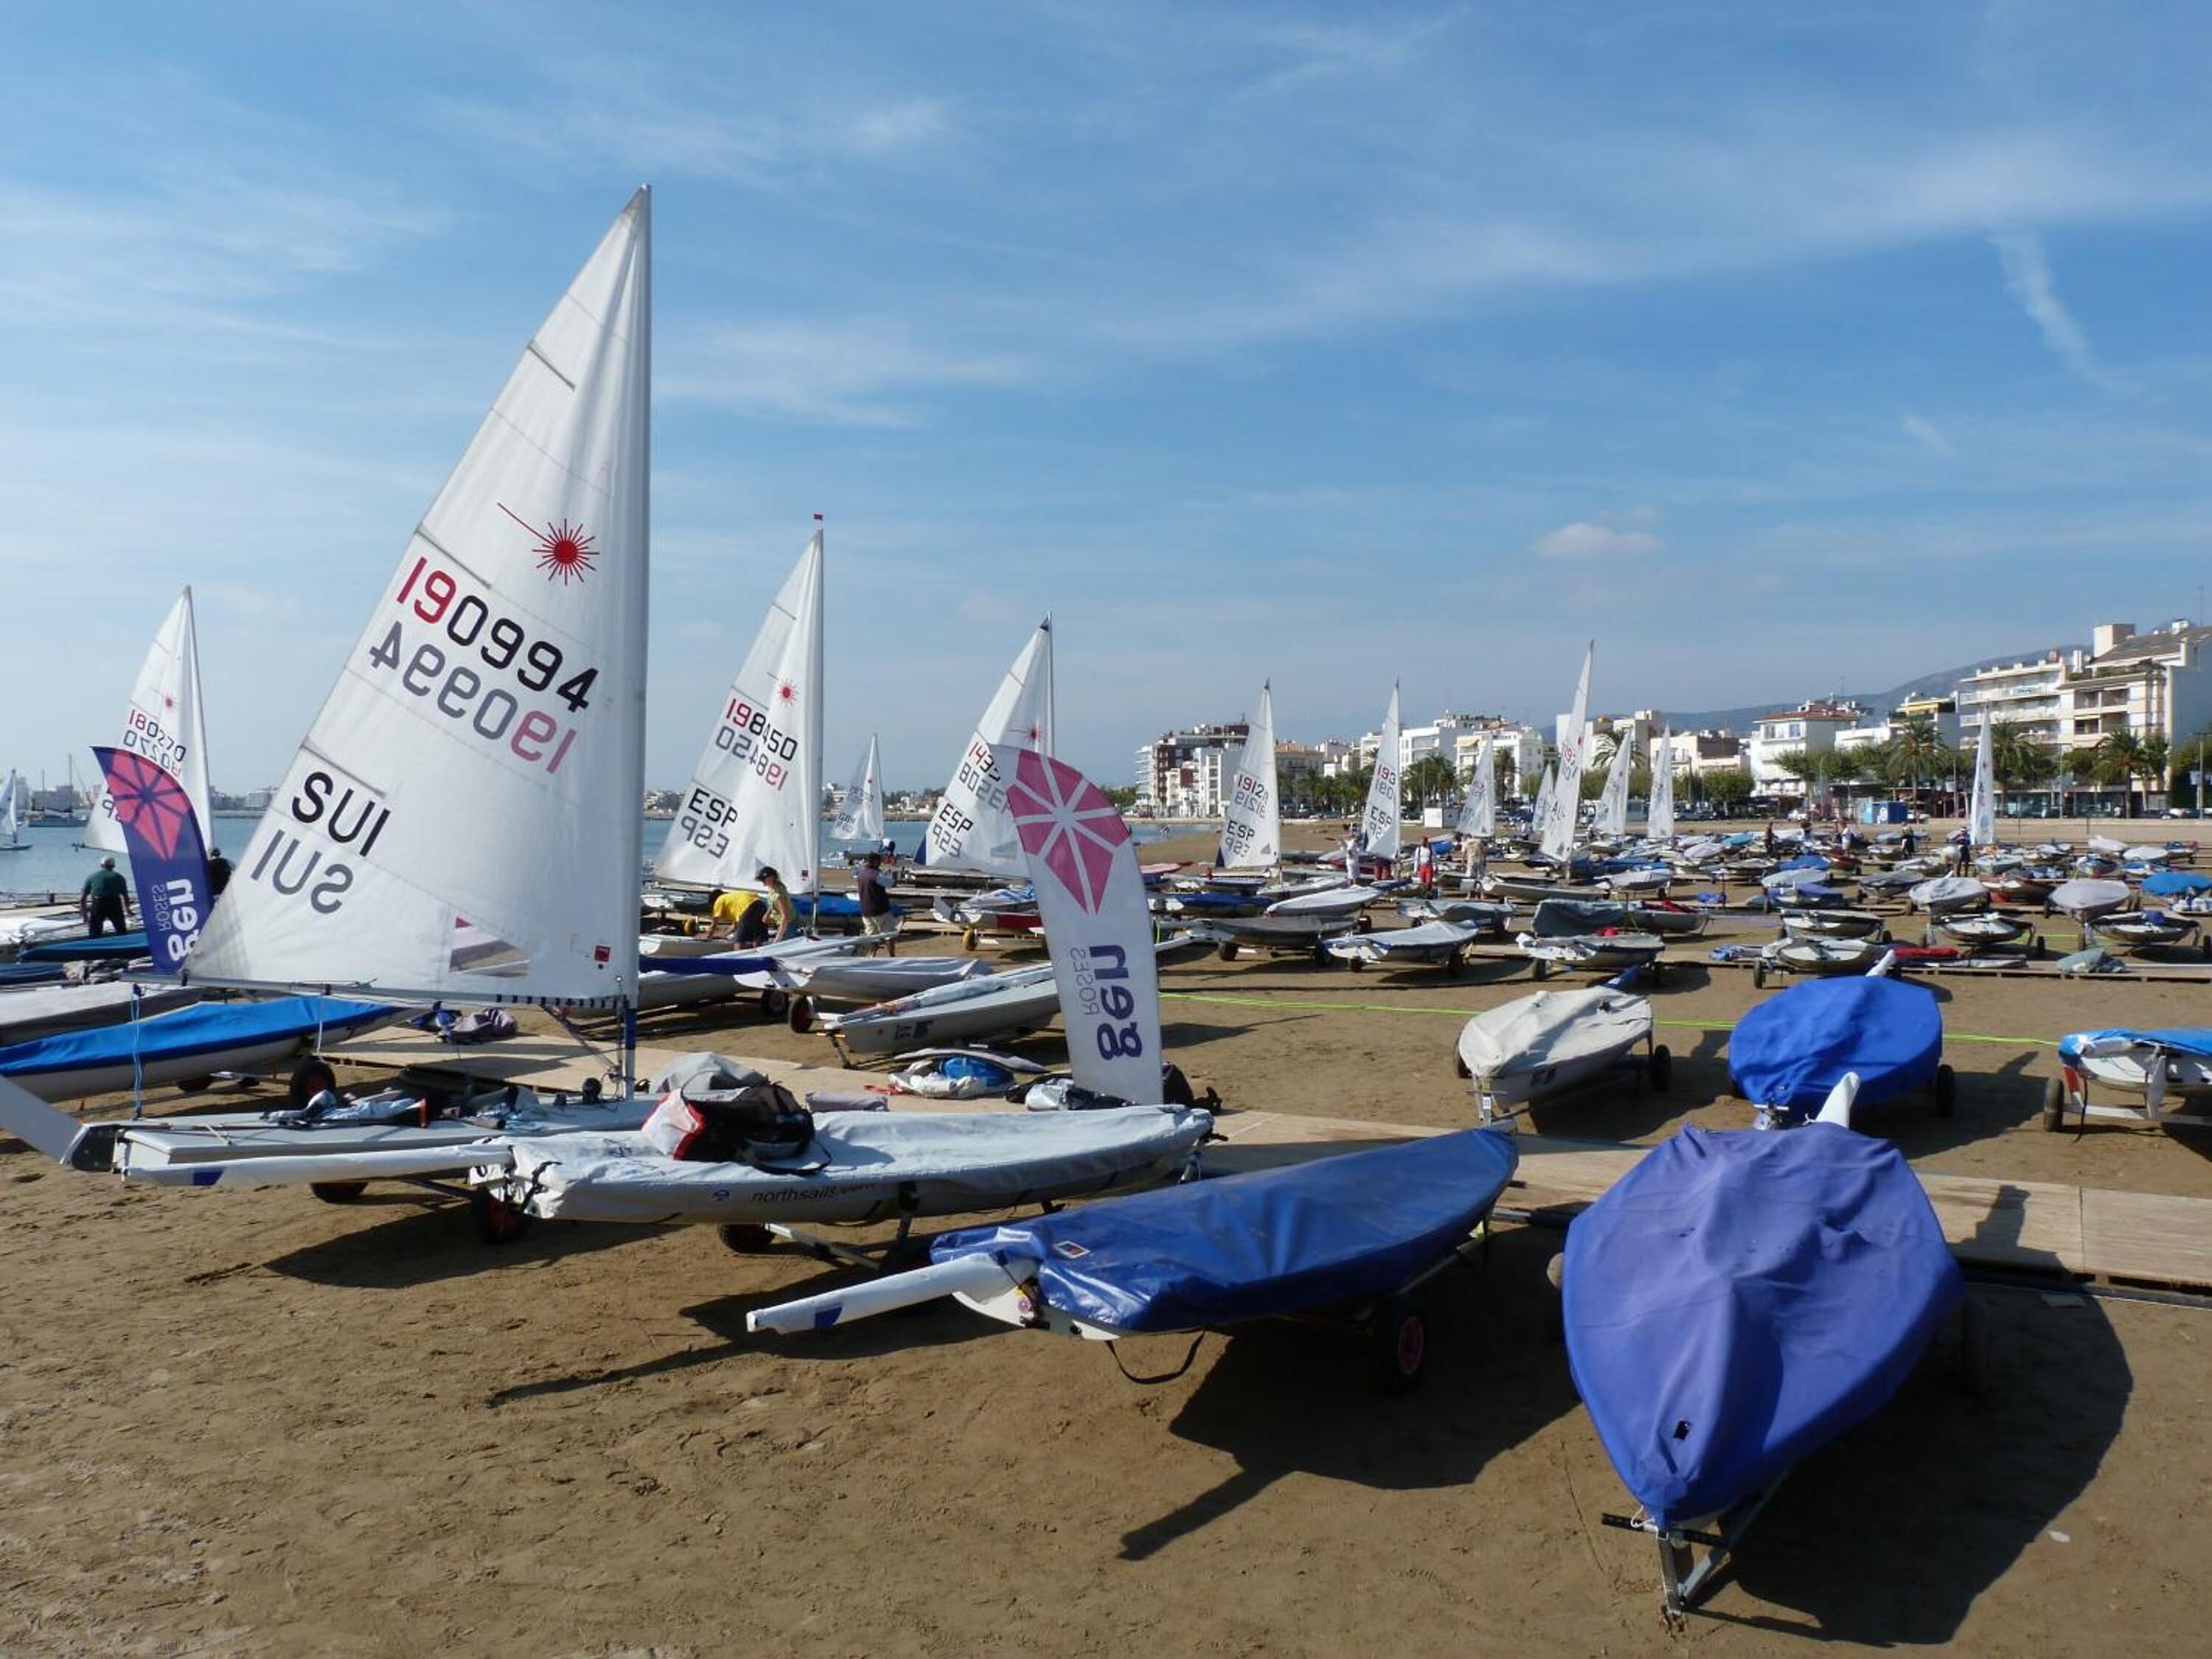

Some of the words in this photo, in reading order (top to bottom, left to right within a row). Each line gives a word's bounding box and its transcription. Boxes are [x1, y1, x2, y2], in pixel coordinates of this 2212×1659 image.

[396, 557, 599, 713] 190994
[129, 709, 186, 762] 180270
[726, 698, 798, 762] 198450
[292, 771, 392, 858] SUI
[688, 787, 739, 828] ESP
[939, 803, 974, 833] ESP
[1226, 820, 1255, 841] ESP
